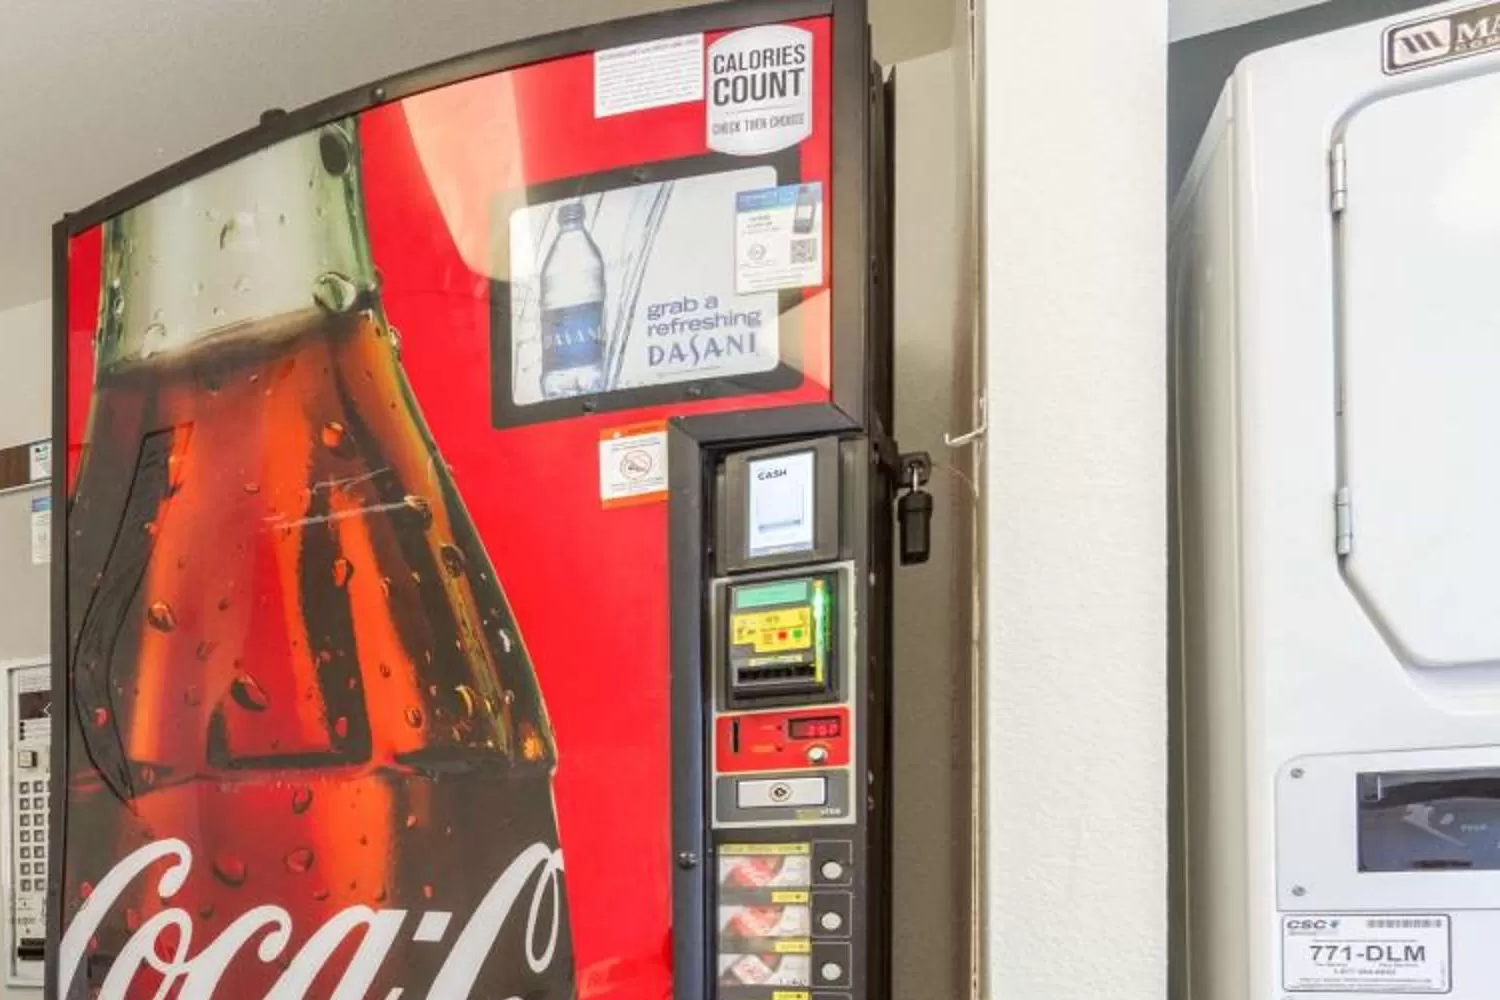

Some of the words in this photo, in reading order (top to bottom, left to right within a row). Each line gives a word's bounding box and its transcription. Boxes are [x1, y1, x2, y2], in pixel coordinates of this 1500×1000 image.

[713, 43, 805, 75] CALORIES
[713, 68, 805, 107] COUNT
[647, 296, 698, 321] grab
[704, 296, 718, 310] a
[647, 309, 762, 336] refreshing
[647, 332, 756, 367] DASANI
[757, 468, 788, 481] CASH
[1309, 944, 1426, 962] 771-DLM
